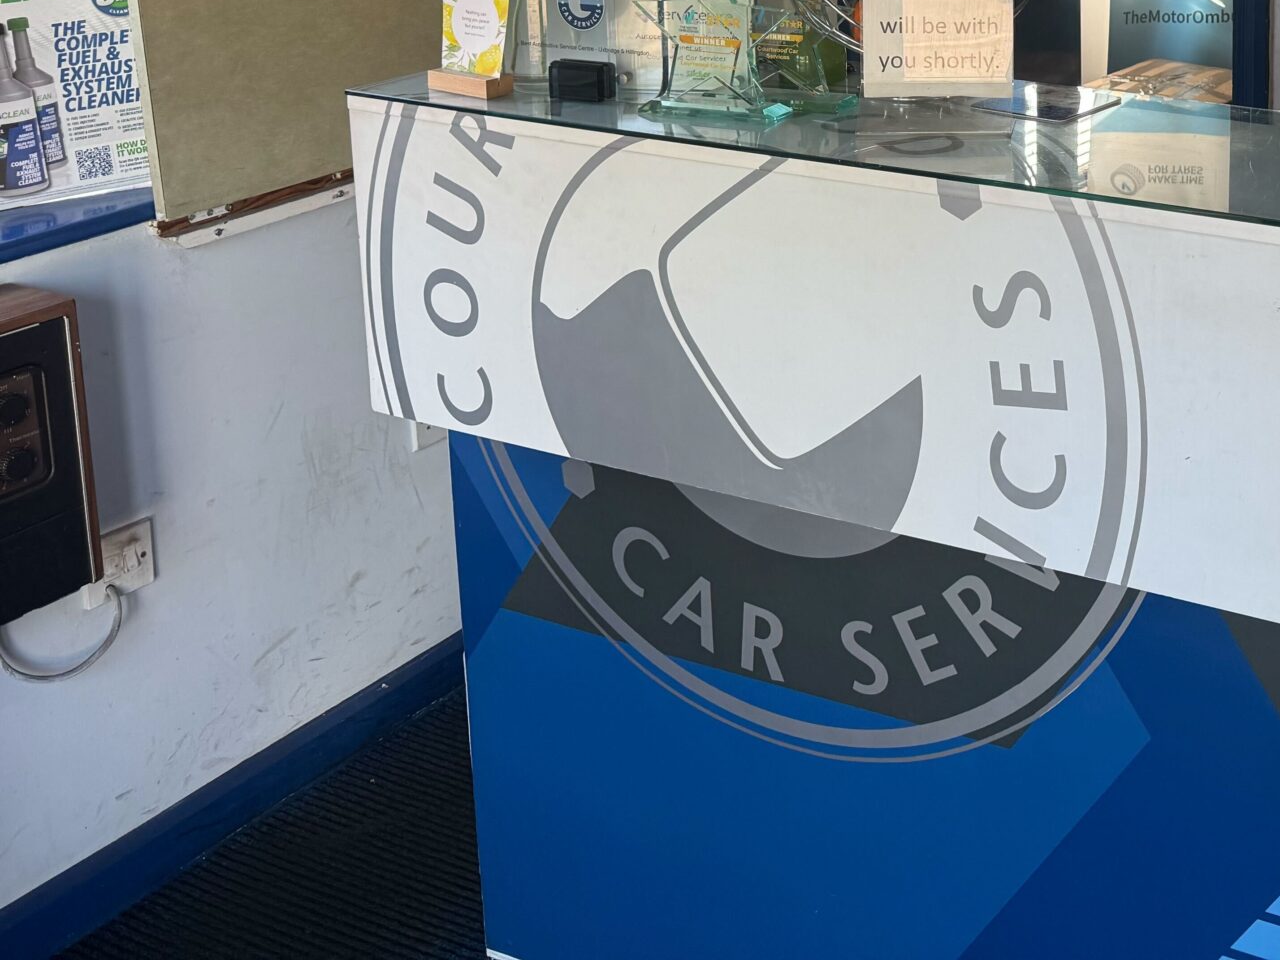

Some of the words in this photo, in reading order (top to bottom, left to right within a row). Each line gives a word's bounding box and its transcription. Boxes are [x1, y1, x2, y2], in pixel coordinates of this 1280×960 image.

[561, 6, 572, 21] CAR
[573, 9, 602, 28] SERVICES
[879, 16, 915, 34] will
[922, 16, 947, 34] be
[953, 16, 999, 34] with
[51, 19, 87, 38] THE
[54, 29, 133, 53] COMPLE
[693, 37, 726, 46] WINNER
[57, 49, 102, 68] FUEL
[106, 46, 120, 61] &
[878, 55, 916, 73] you
[923, 51, 1000, 71] shortly.
[60, 59, 136, 83] EXHAUS
[62, 74, 133, 99] SYSTEM
[116, 140, 138, 150] HOW
[612, 526, 785, 682] CAR
[840, 269, 1069, 697] SERVICES
